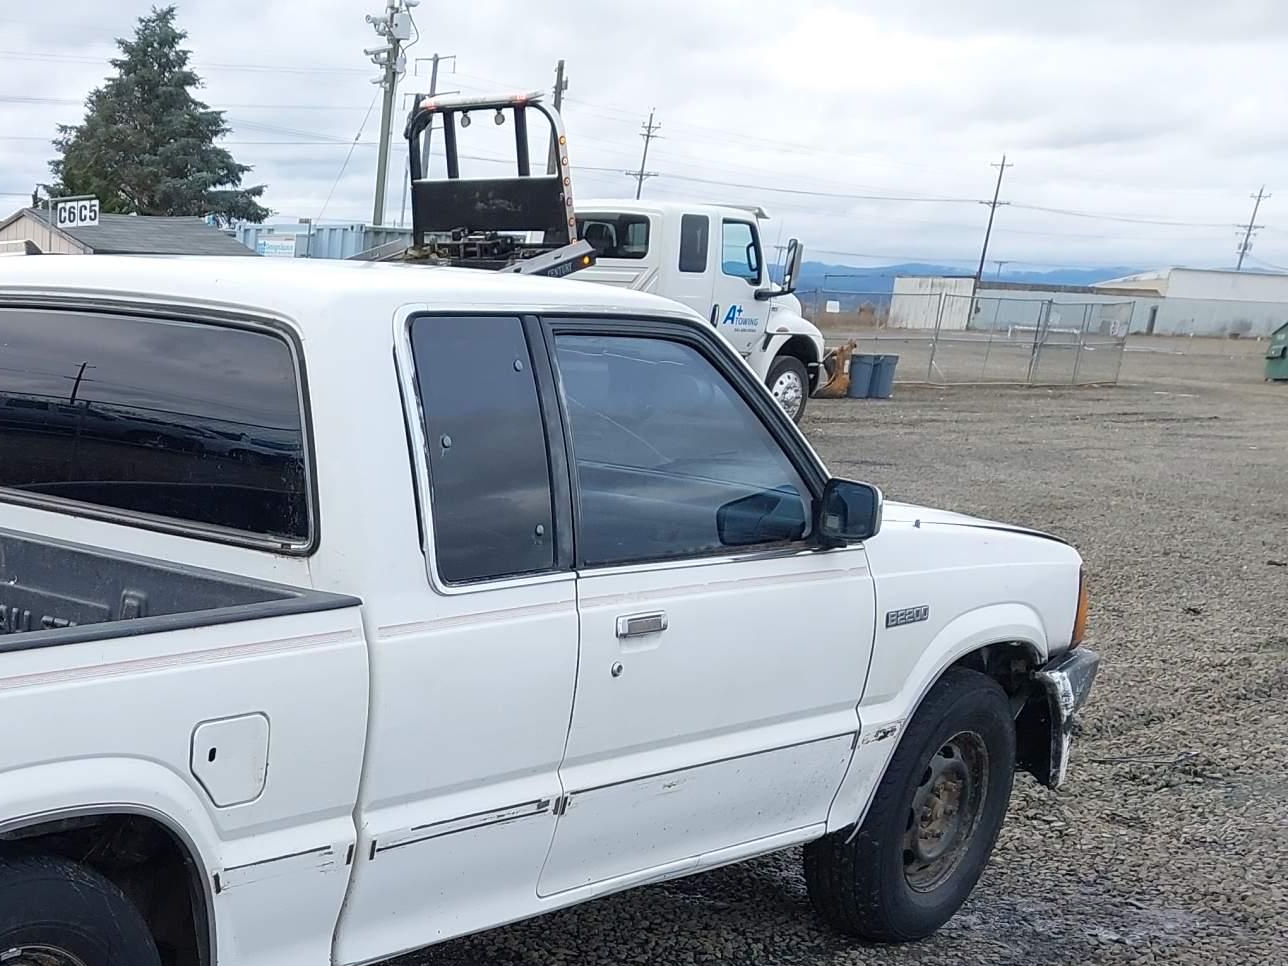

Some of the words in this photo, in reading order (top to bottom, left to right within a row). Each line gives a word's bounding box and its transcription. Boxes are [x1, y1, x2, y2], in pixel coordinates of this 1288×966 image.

[59, 205, 76, 224] C6
[79, 204, 97, 222] C5
[735, 317, 759, 327] TOWING
[887, 606, 929, 627] B2200
